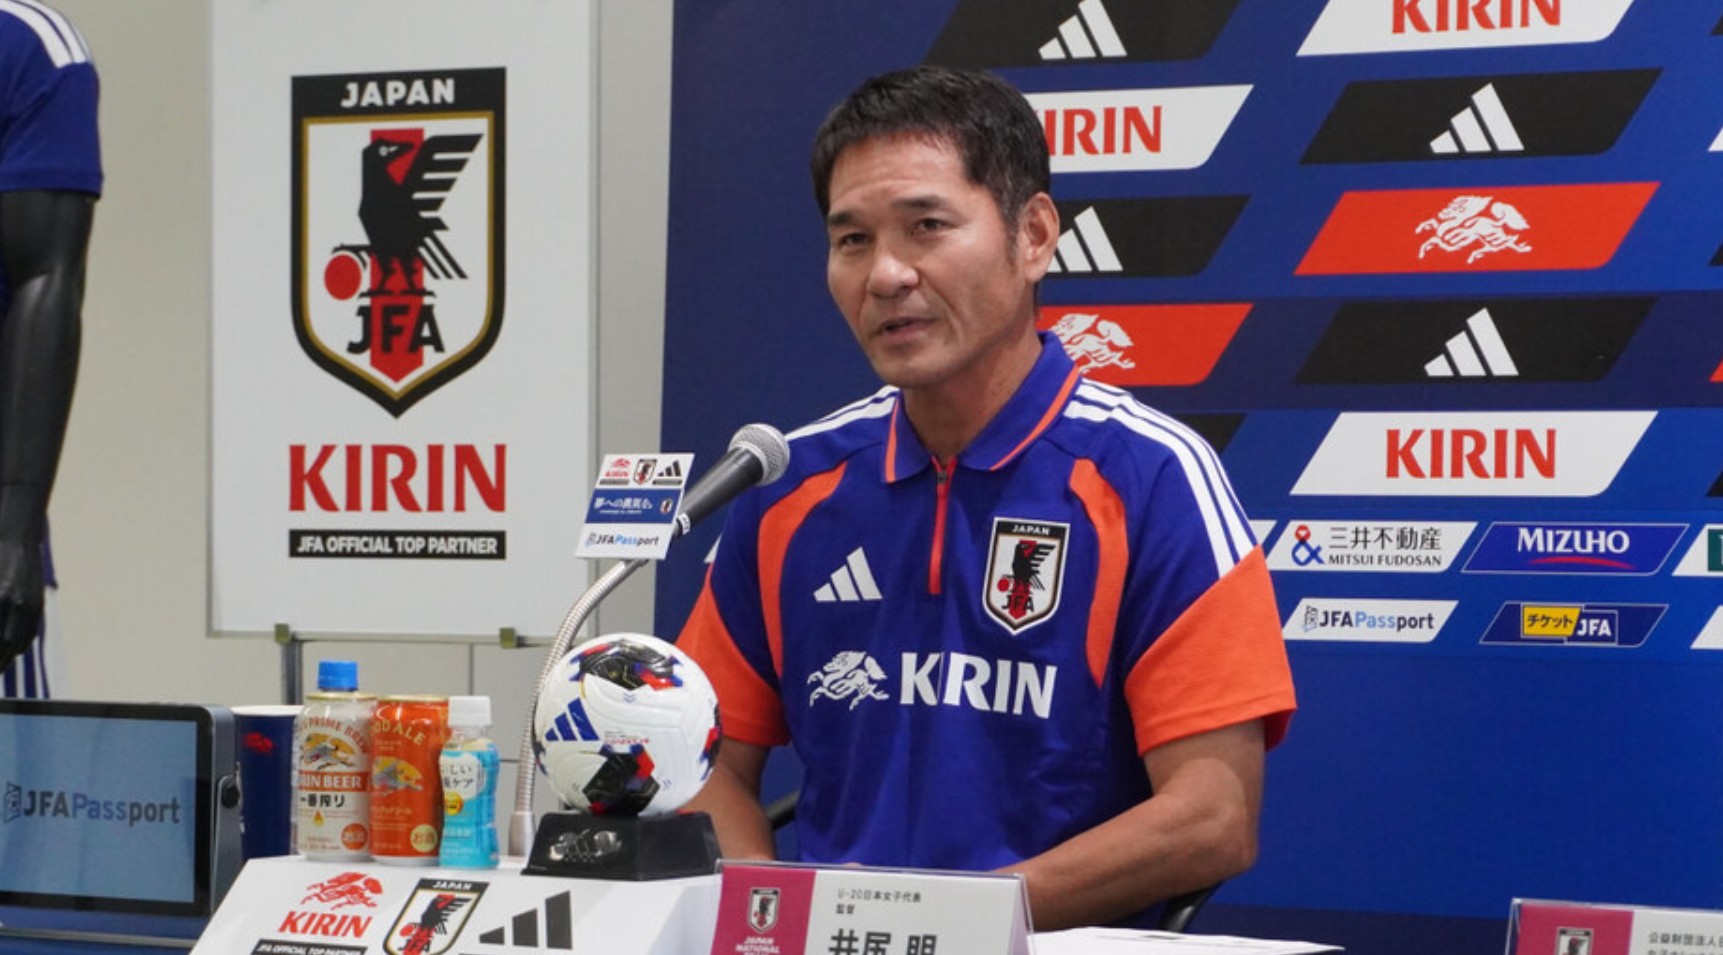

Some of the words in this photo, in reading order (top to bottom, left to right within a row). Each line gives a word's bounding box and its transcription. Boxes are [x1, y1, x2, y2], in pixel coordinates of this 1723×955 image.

[1392, 0, 1561, 34] KIRIN
[340, 78, 455, 108] JAPAN
[1036, 105, 1162, 156] IRIN
[346, 304, 445, 354] JFA
[1386, 428, 1556, 479] KIRIN
[288, 444, 507, 512] KIRIN
[1012, 524, 1050, 535] JAPAN
[1329, 526, 1442, 550] 三井不動産
[1518, 527, 1630, 553] MIZUHO
[298, 536, 325, 552] JFA
[326, 536, 393, 553] OFFICIAL
[395, 538, 426, 553] TOP
[428, 538, 498, 554] PARTNER
[1329, 554, 1374, 566] MITSUI
[1377, 554, 1442, 566] FUDOSAN
[1001, 594, 1034, 612] JFA
[1527, 614, 1573, 628] チケット
[1577, 619, 1612, 637] JFA
[393, 721, 426, 746] ALE
[323, 776, 361, 789] BEER
[432, 881, 472, 892] JAPAN
[278, 911, 373, 939] KIRIN
